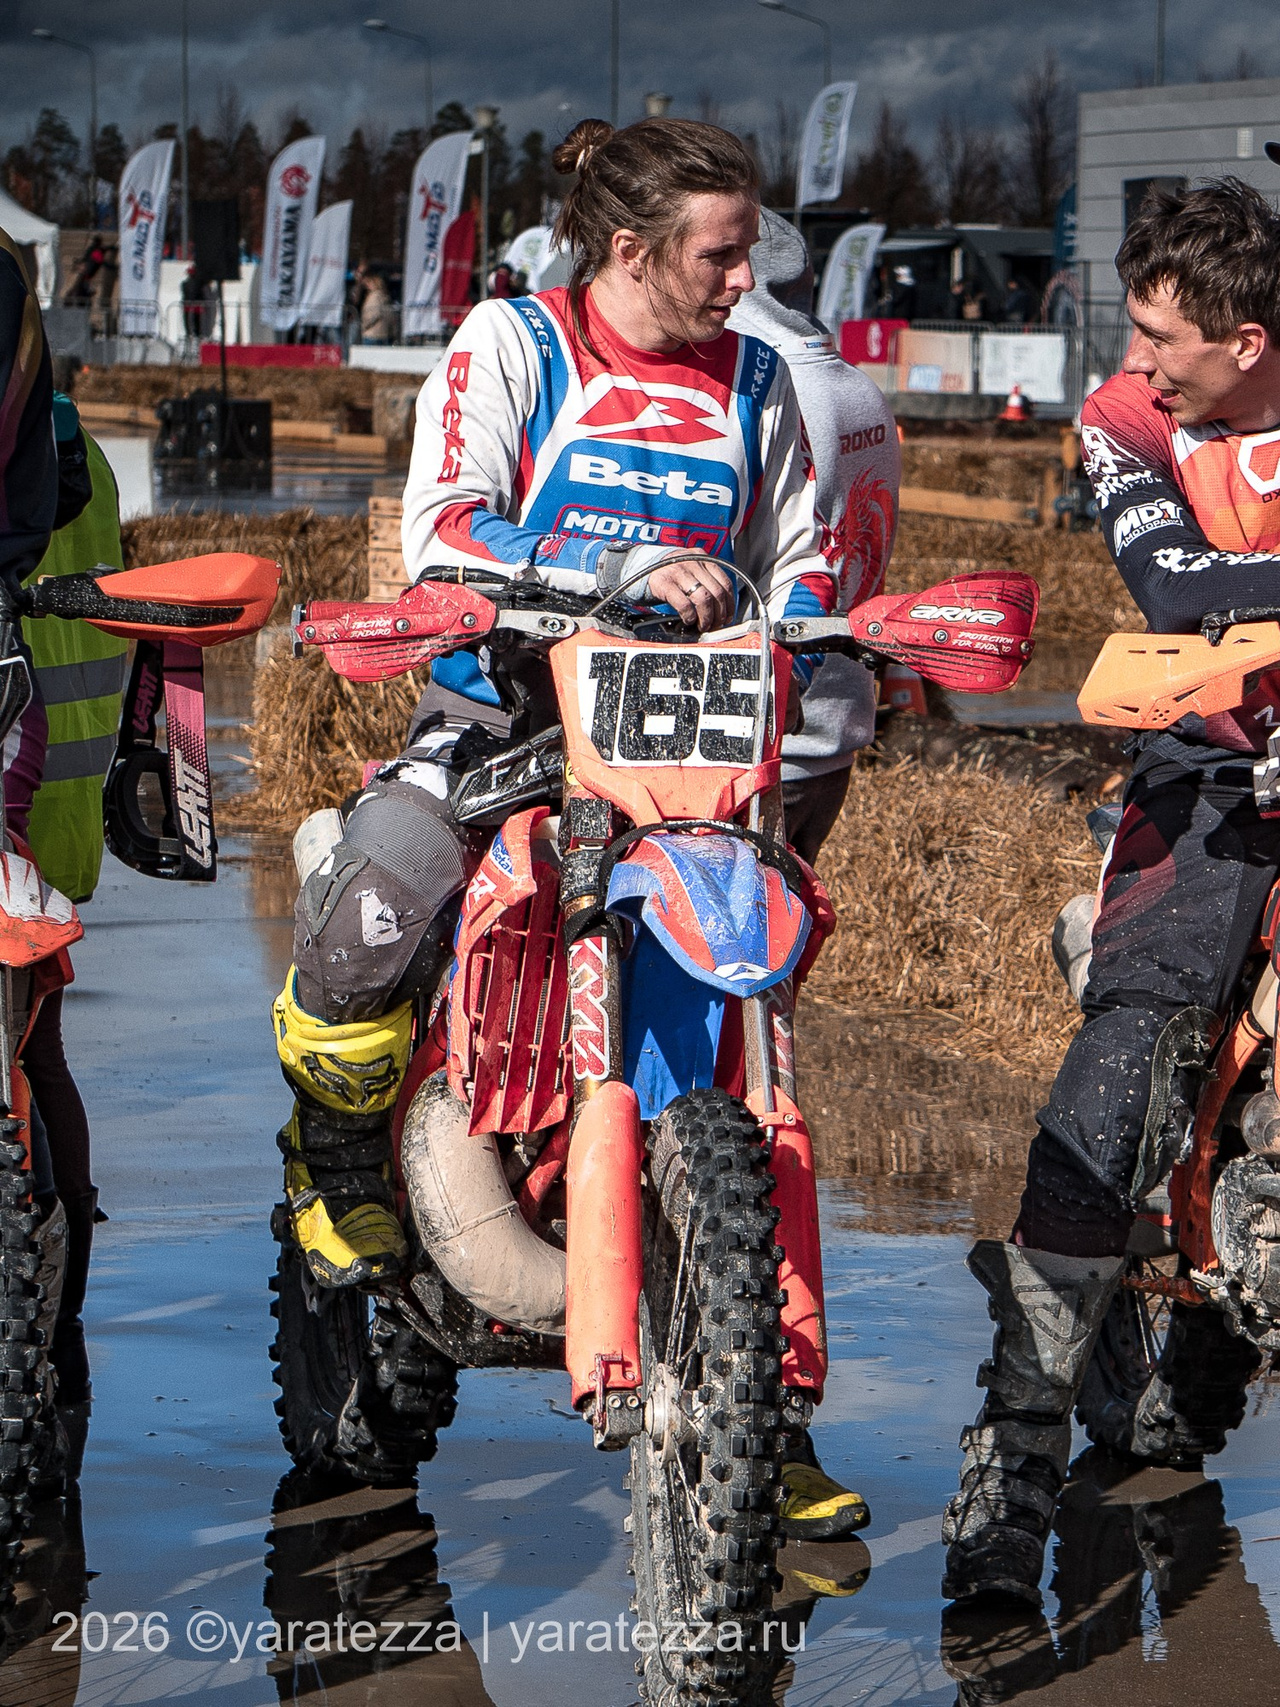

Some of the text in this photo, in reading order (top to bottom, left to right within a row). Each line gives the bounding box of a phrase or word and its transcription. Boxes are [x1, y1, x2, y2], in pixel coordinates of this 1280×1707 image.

[437, 351, 473, 484] Beta
[569, 453, 734, 508] Beta
[952, 639, 973, 648] FOR
[958, 631, 1014, 644] PROTECTION
[588, 651, 774, 764] 165
[173, 748, 212, 868] LEATT
[492, 845, 512, 870] Beta
